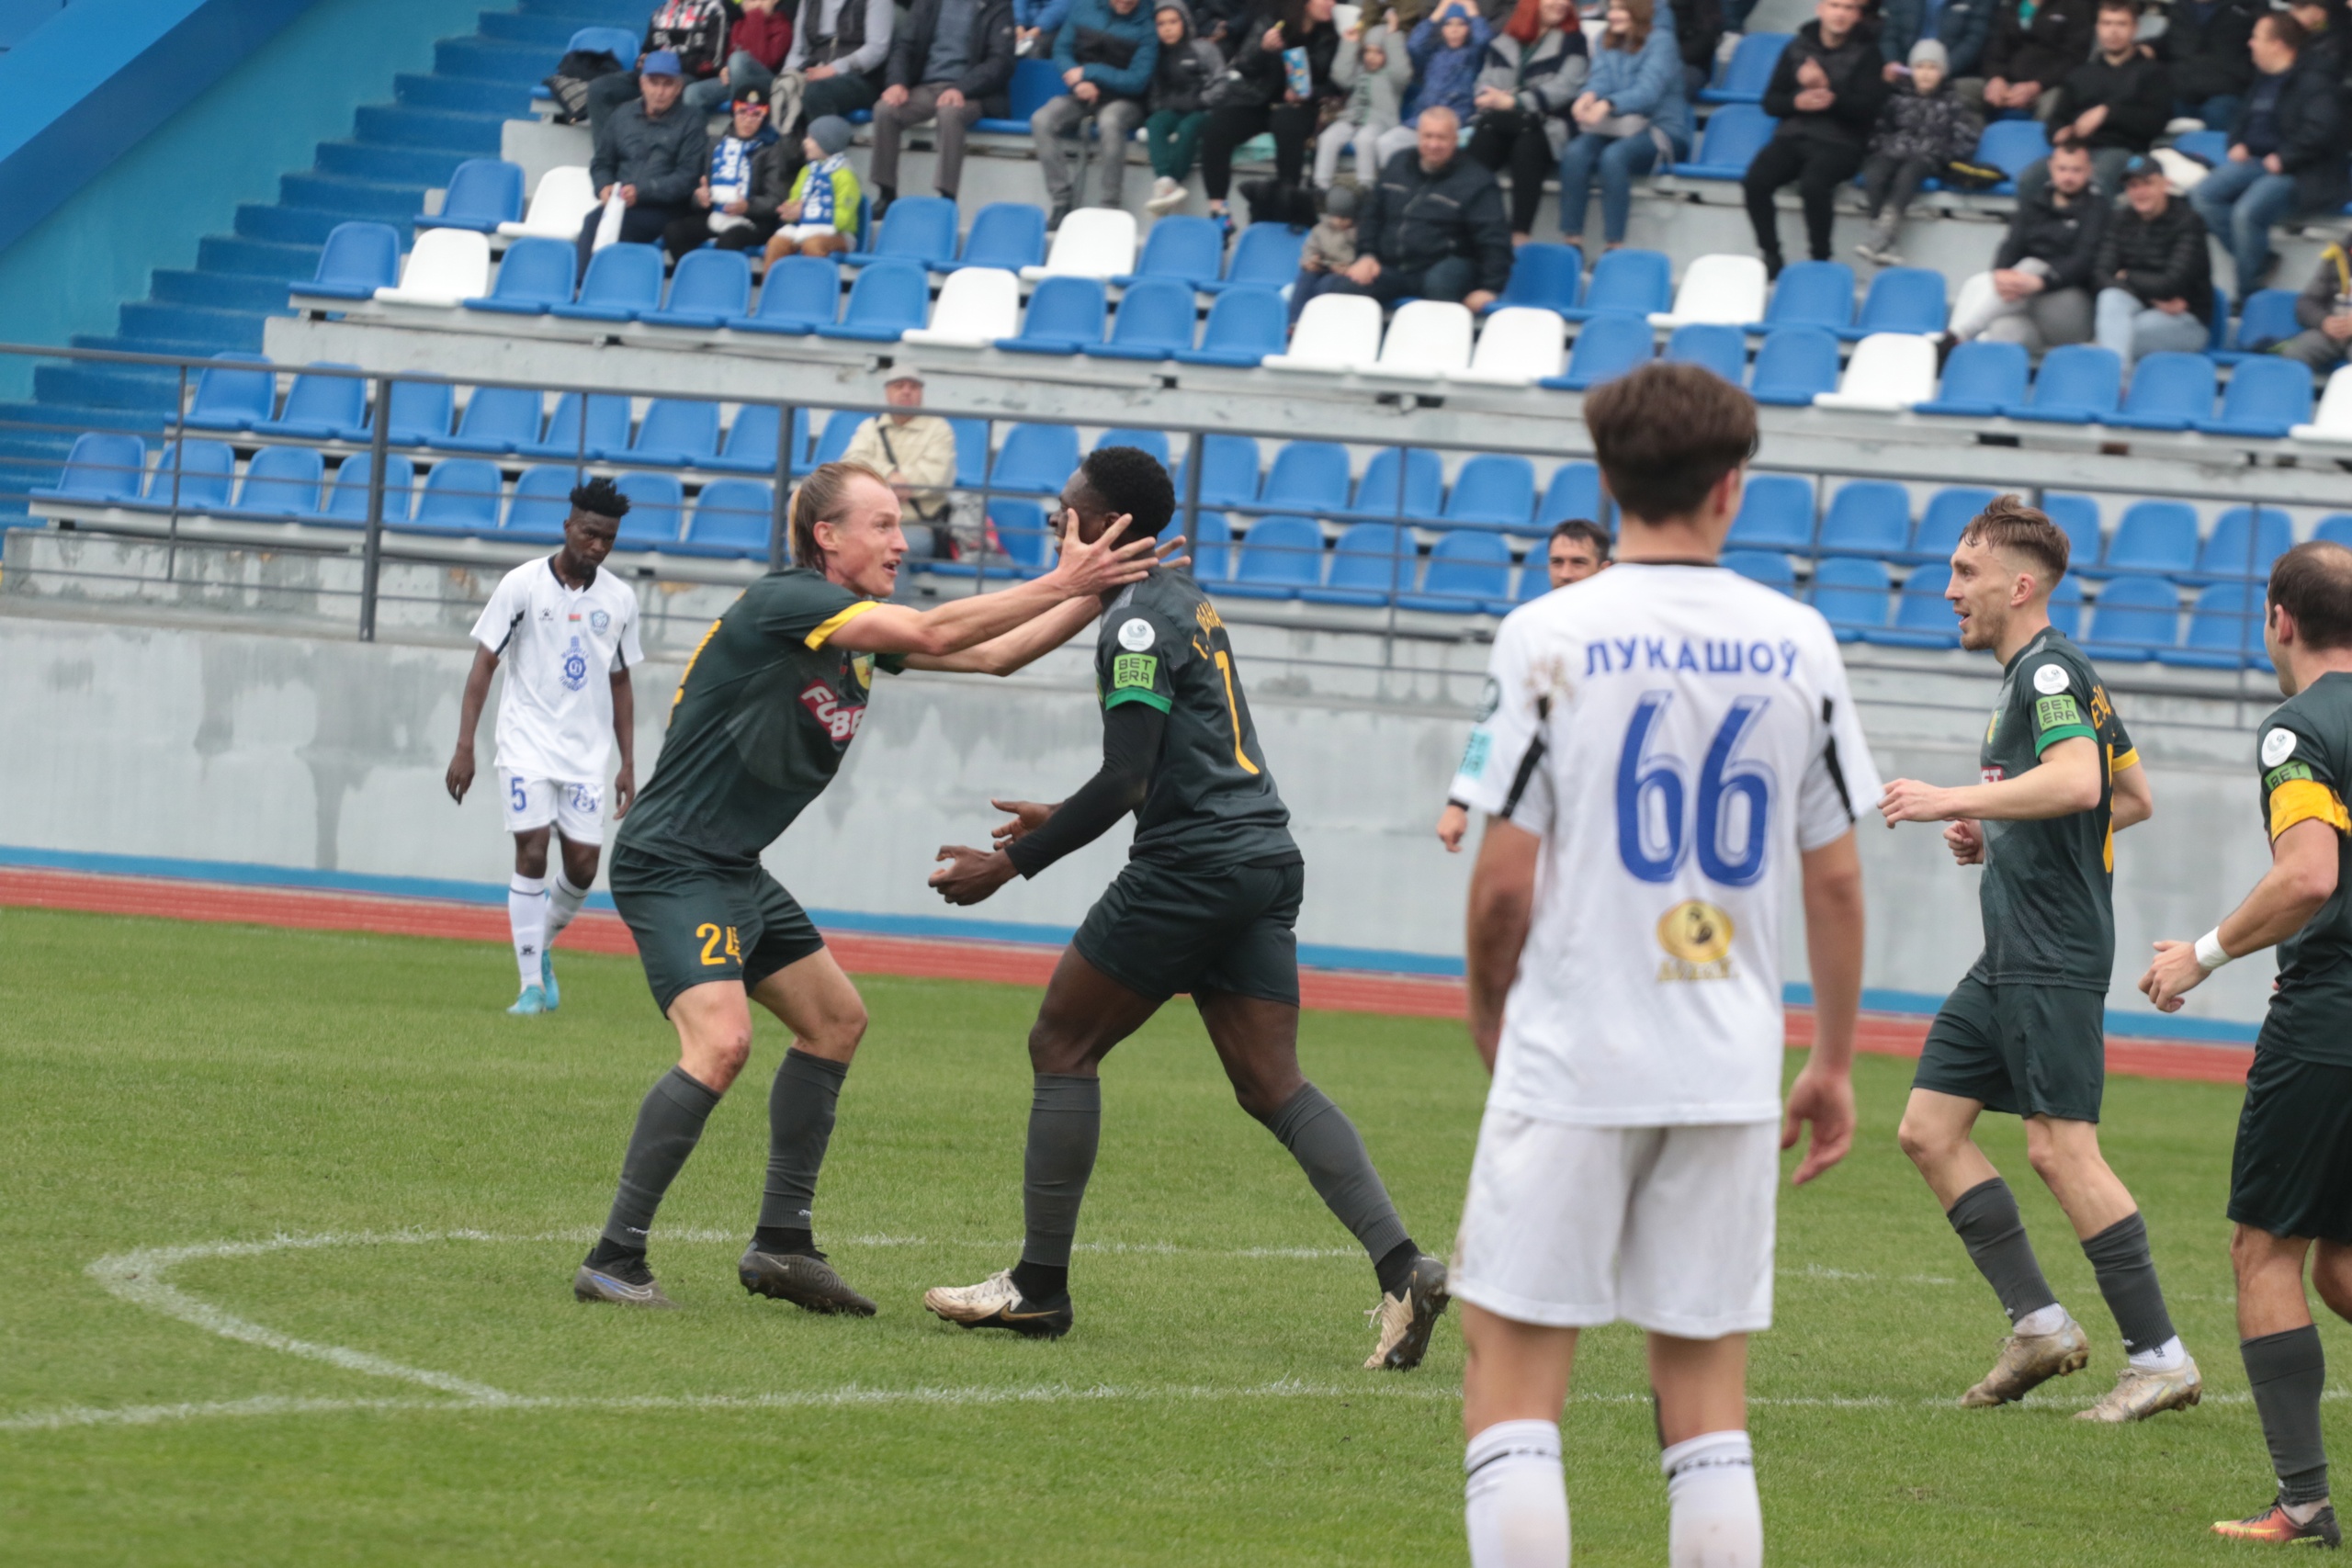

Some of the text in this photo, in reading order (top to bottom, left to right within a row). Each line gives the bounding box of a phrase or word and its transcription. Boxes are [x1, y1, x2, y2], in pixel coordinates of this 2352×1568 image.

[1118, 658, 1152, 671] BET
[1586, 636, 1798, 678] ЛУКАШОЎ
[2040, 699, 2072, 714] BET
[511, 776, 527, 812] 5
[1615, 689, 1778, 888] 66
